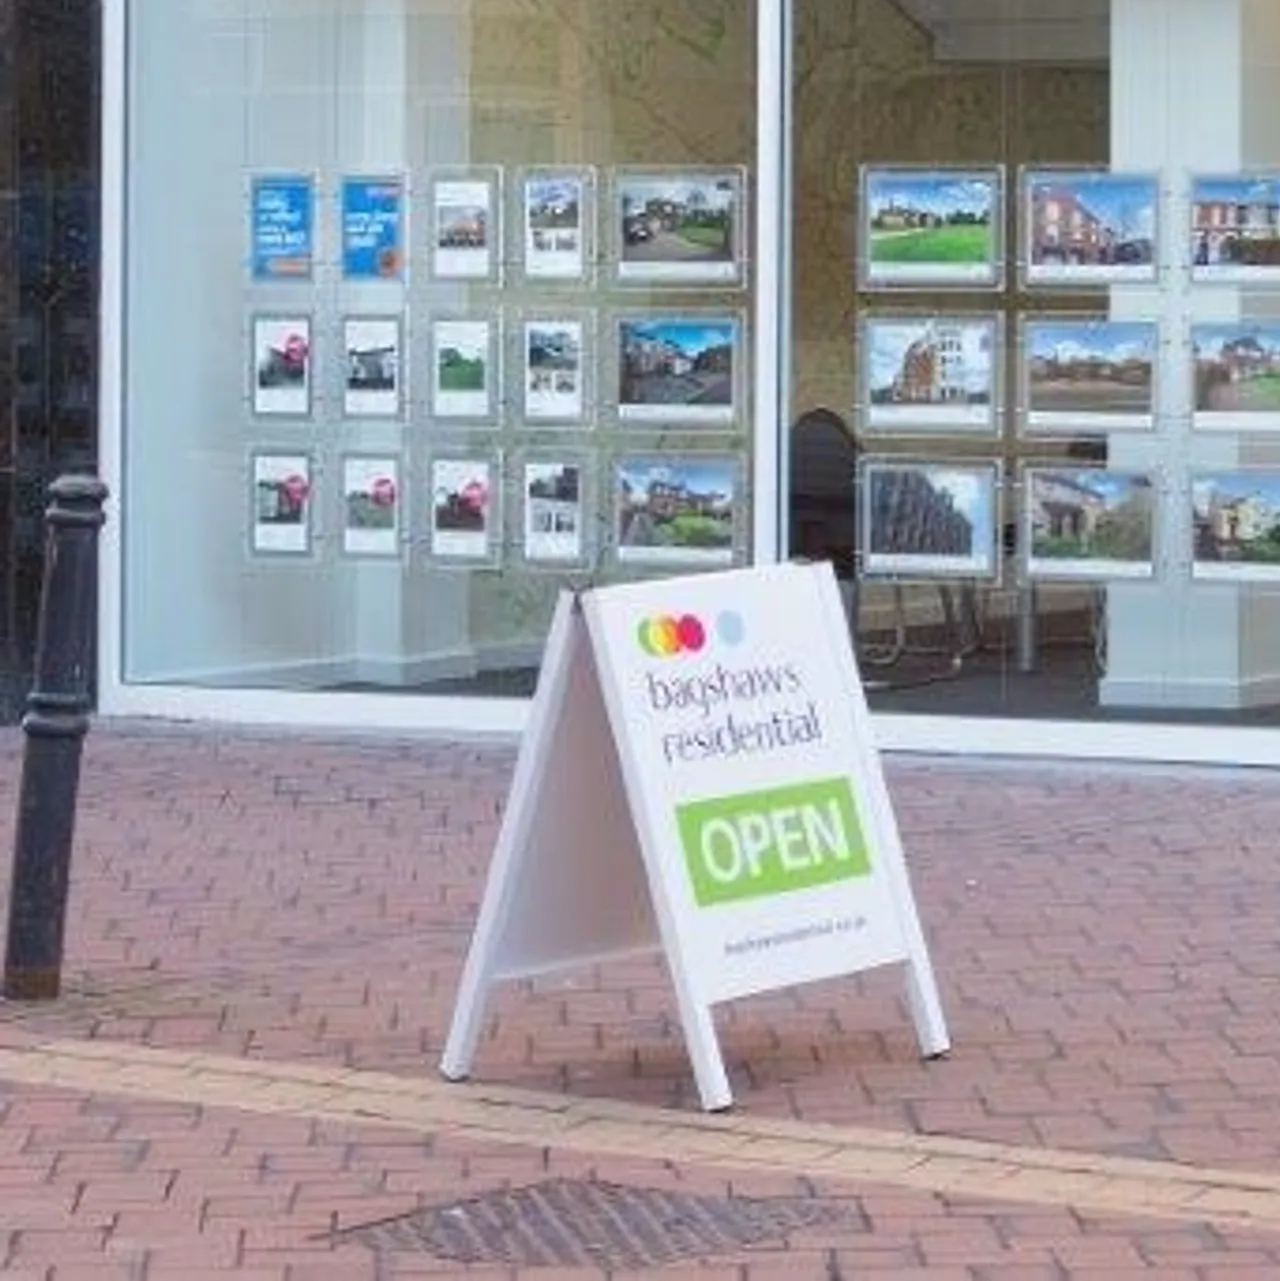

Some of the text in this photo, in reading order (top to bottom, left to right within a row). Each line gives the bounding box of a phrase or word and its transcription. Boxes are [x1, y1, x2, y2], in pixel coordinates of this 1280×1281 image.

[647, 663, 801, 717] bagshaws
[661, 700, 823, 765] residential
[701, 797, 850, 883] OPEN
